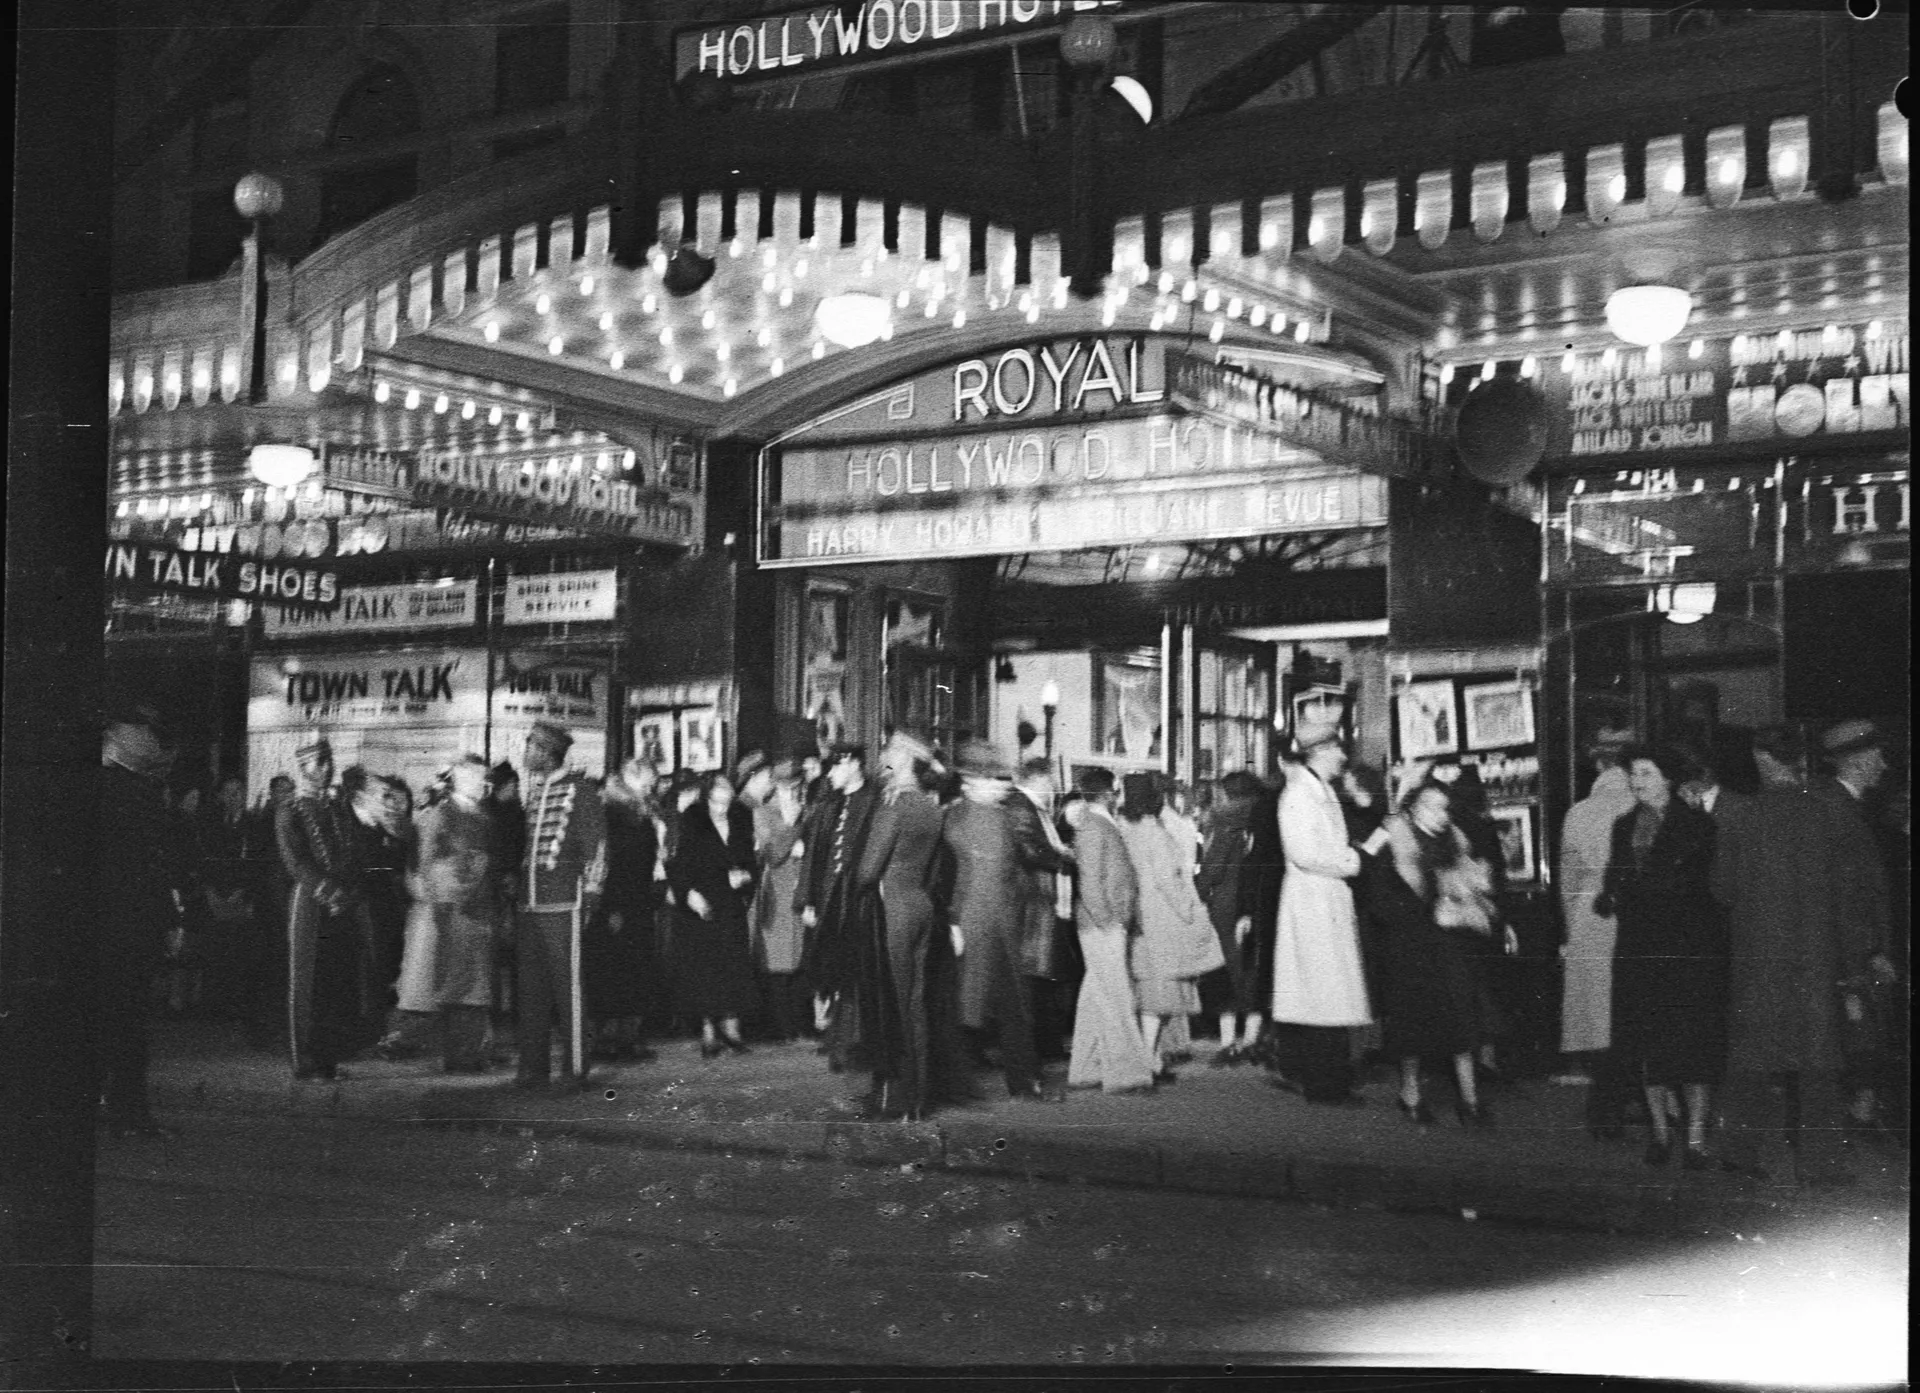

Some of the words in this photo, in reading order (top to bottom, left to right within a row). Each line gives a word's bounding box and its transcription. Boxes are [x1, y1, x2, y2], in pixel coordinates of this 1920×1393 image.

[698, 0, 961, 78] HOLLYWOOD
[954, 339, 1164, 421] ROYAL
[847, 429, 1110, 497] HOLLYWOOD
[148, 550, 221, 589] TALK
[239, 562, 337, 603] SHOES
[286, 670, 369, 705] TOWN
